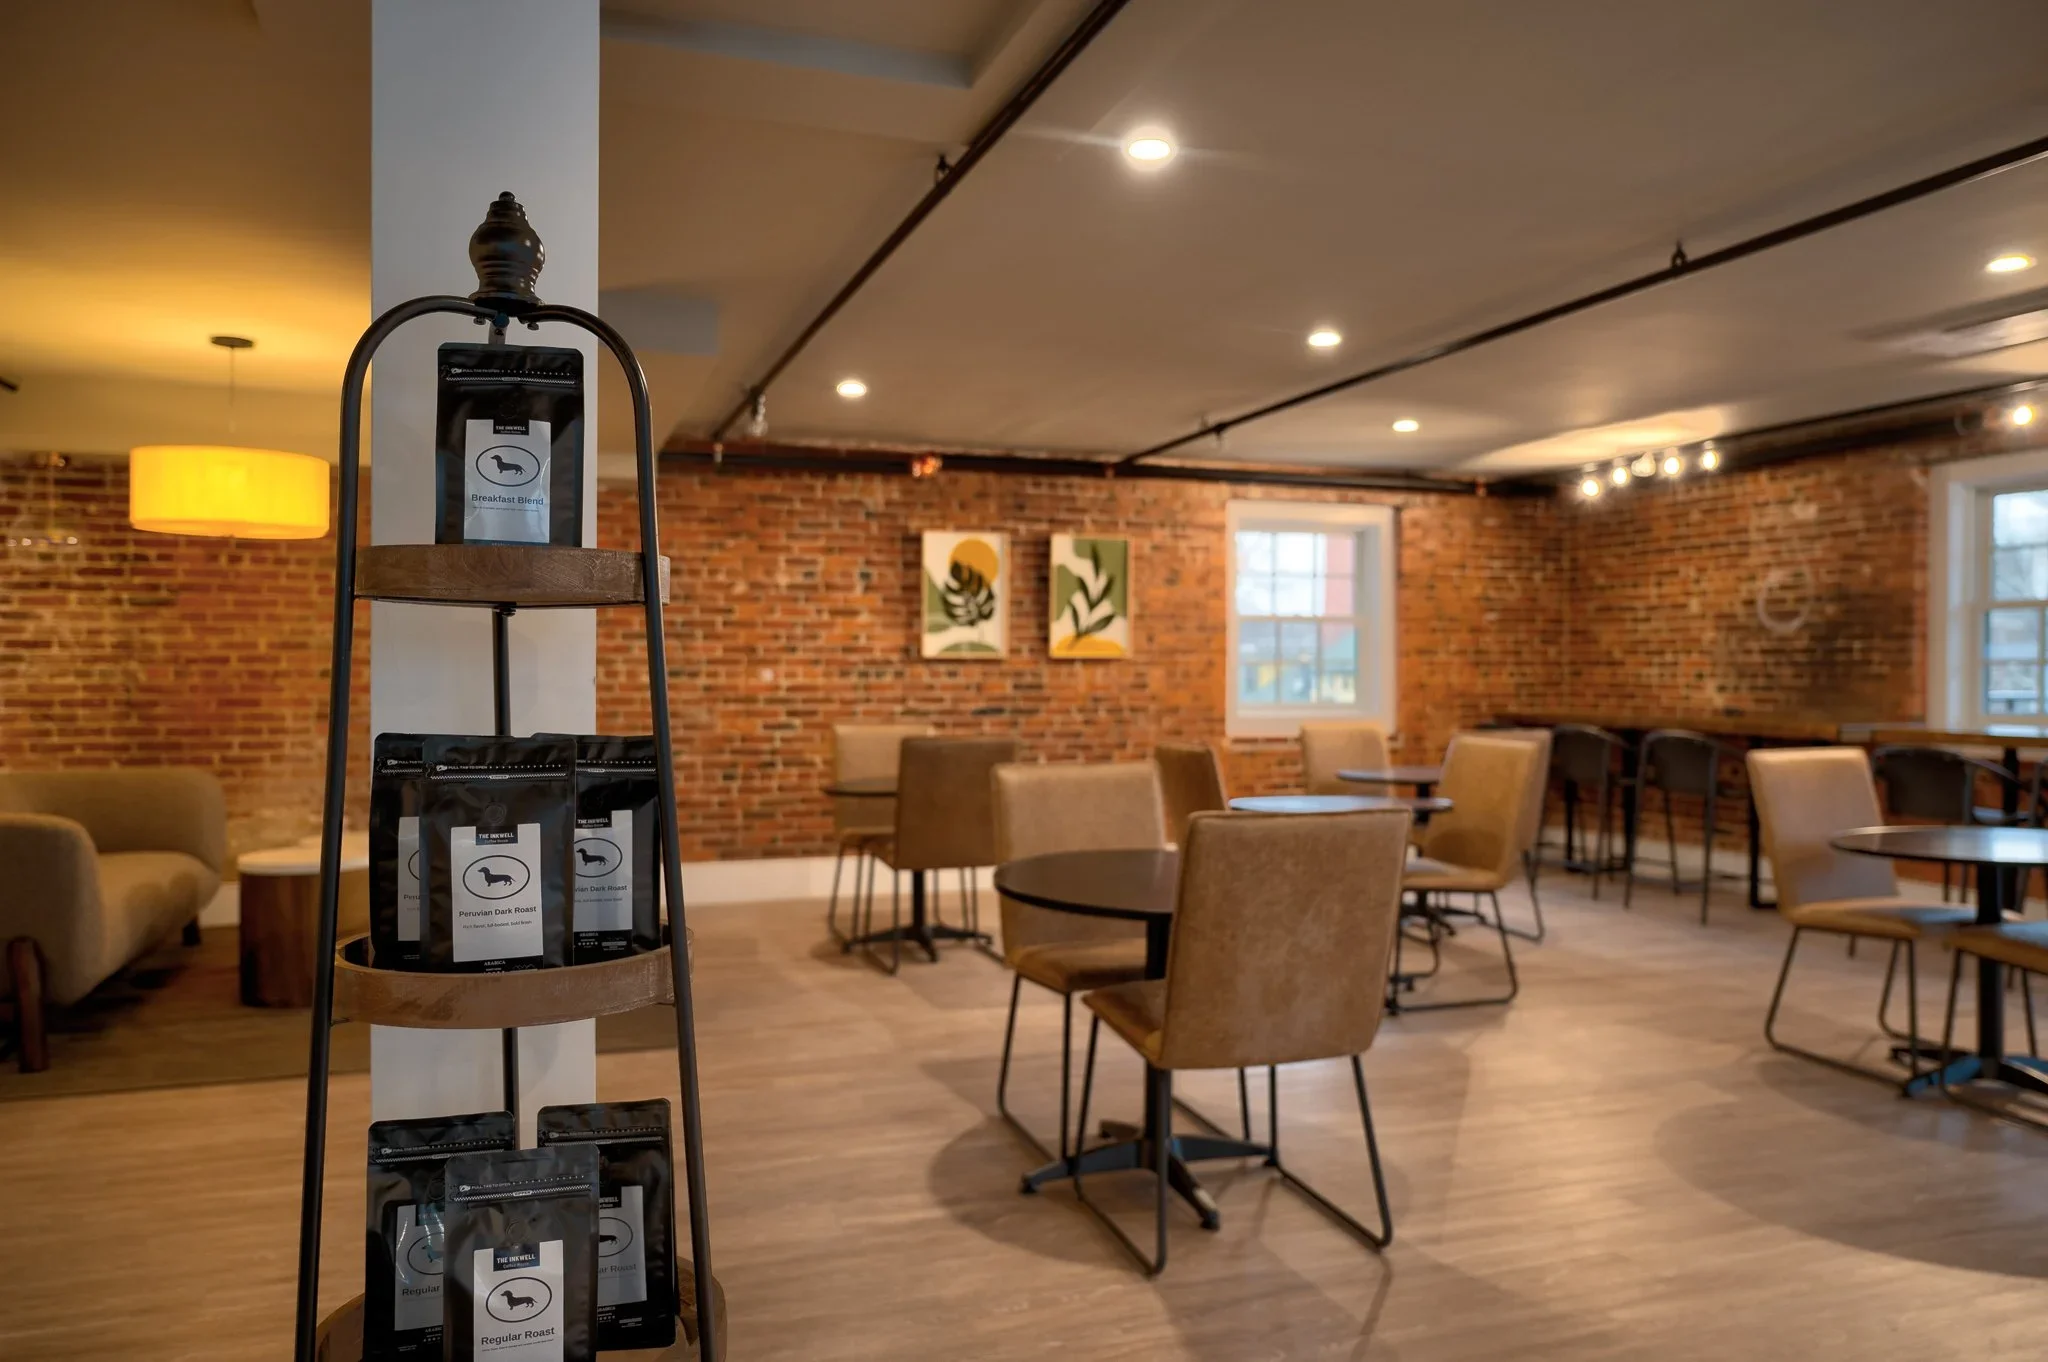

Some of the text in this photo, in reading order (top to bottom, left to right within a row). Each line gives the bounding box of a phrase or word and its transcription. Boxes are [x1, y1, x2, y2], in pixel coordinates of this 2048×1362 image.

[471, 494, 544, 505] Breakfast Blend
[514, 906, 537, 914] Roast
[509, 1253, 536, 1262] INKWELL
[610, 1263, 636, 1272] Roast
[402, 1285, 440, 1296] Regular
[481, 1333, 522, 1346] Regular
[525, 1327, 555, 1339] Roast
